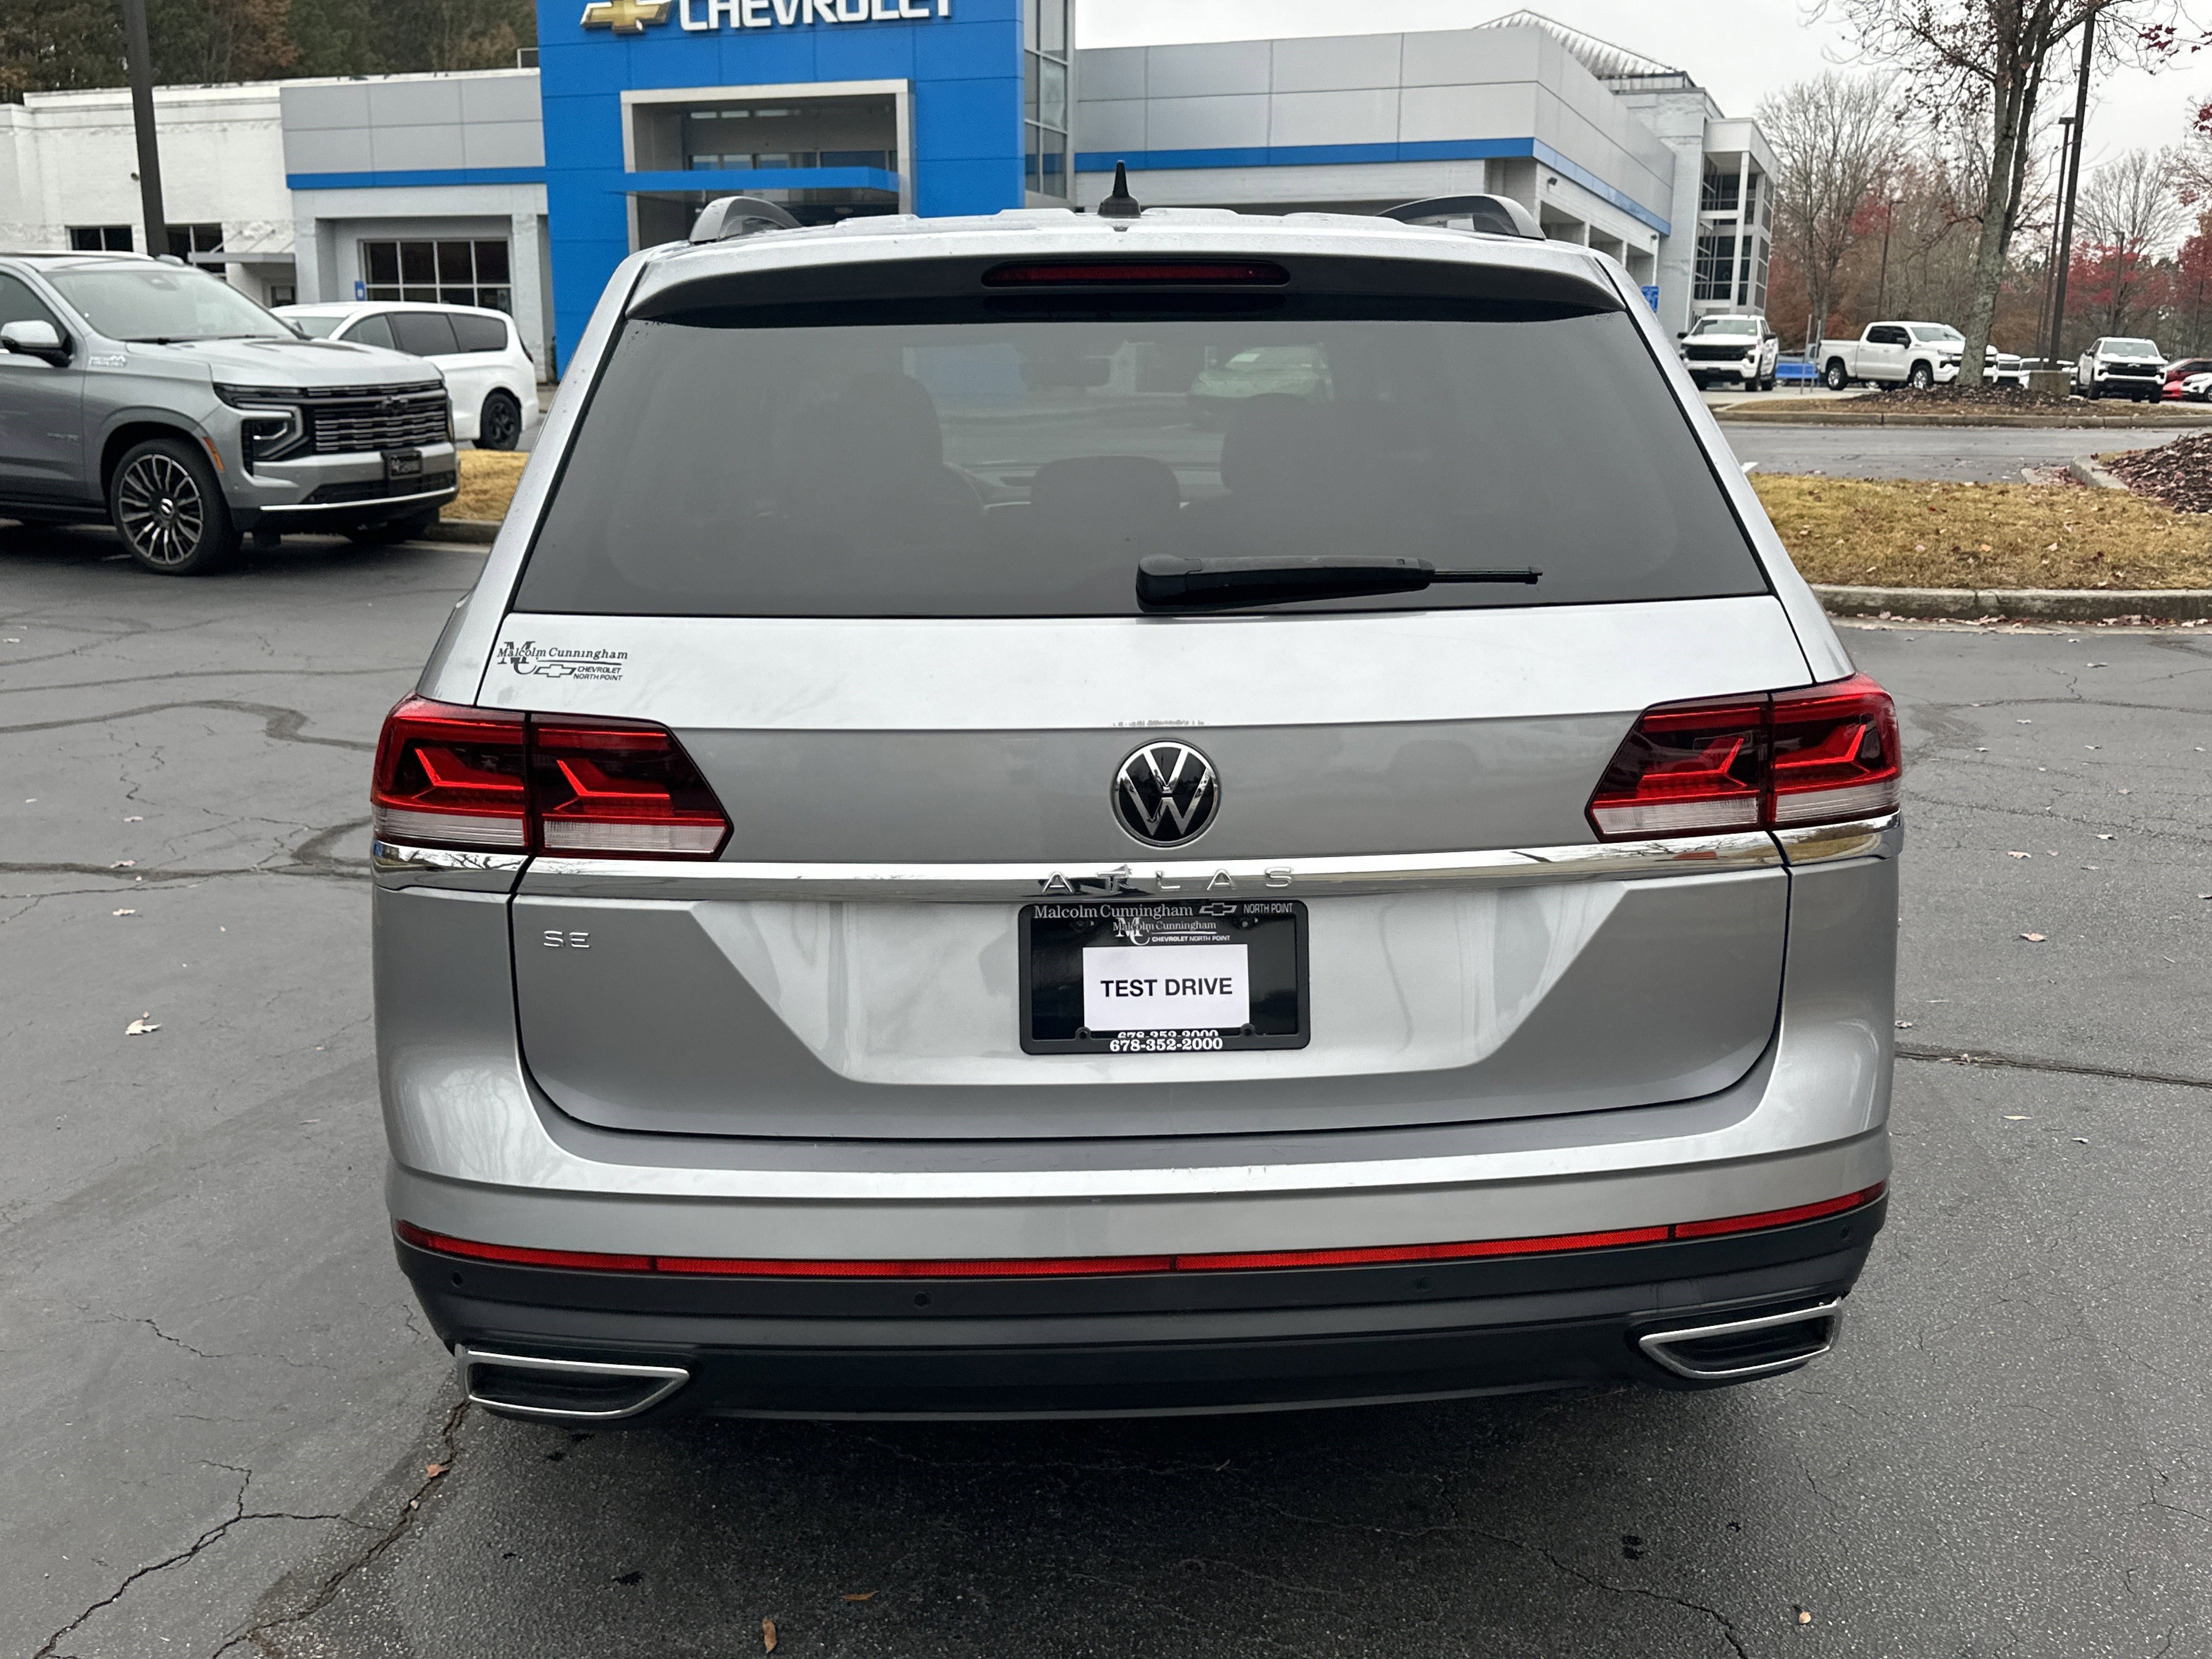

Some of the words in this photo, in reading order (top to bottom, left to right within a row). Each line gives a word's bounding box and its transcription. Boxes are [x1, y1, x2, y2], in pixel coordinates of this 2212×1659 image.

[496, 647, 546, 657] Malcolm
[549, 647, 628, 660] Cunningham
[577, 665, 622, 674] CHEVROLET
[1042, 865, 1293, 894] ATLAS
[1034, 905, 1098, 918] Malcolm
[1100, 904, 1194, 920] Cunningham
[1243, 904, 1270, 913] NORTH
[1271, 902, 1293, 913] POINT
[1113, 921, 1155, 931] Malcolm
[1155, 920, 1216, 931] Cunningham
[543, 930, 590, 948] SE
[1100, 979, 1158, 997] TEST
[1165, 978, 1233, 996] DRIVE
[1109, 1037, 1223, 1052] 678-352-2000
